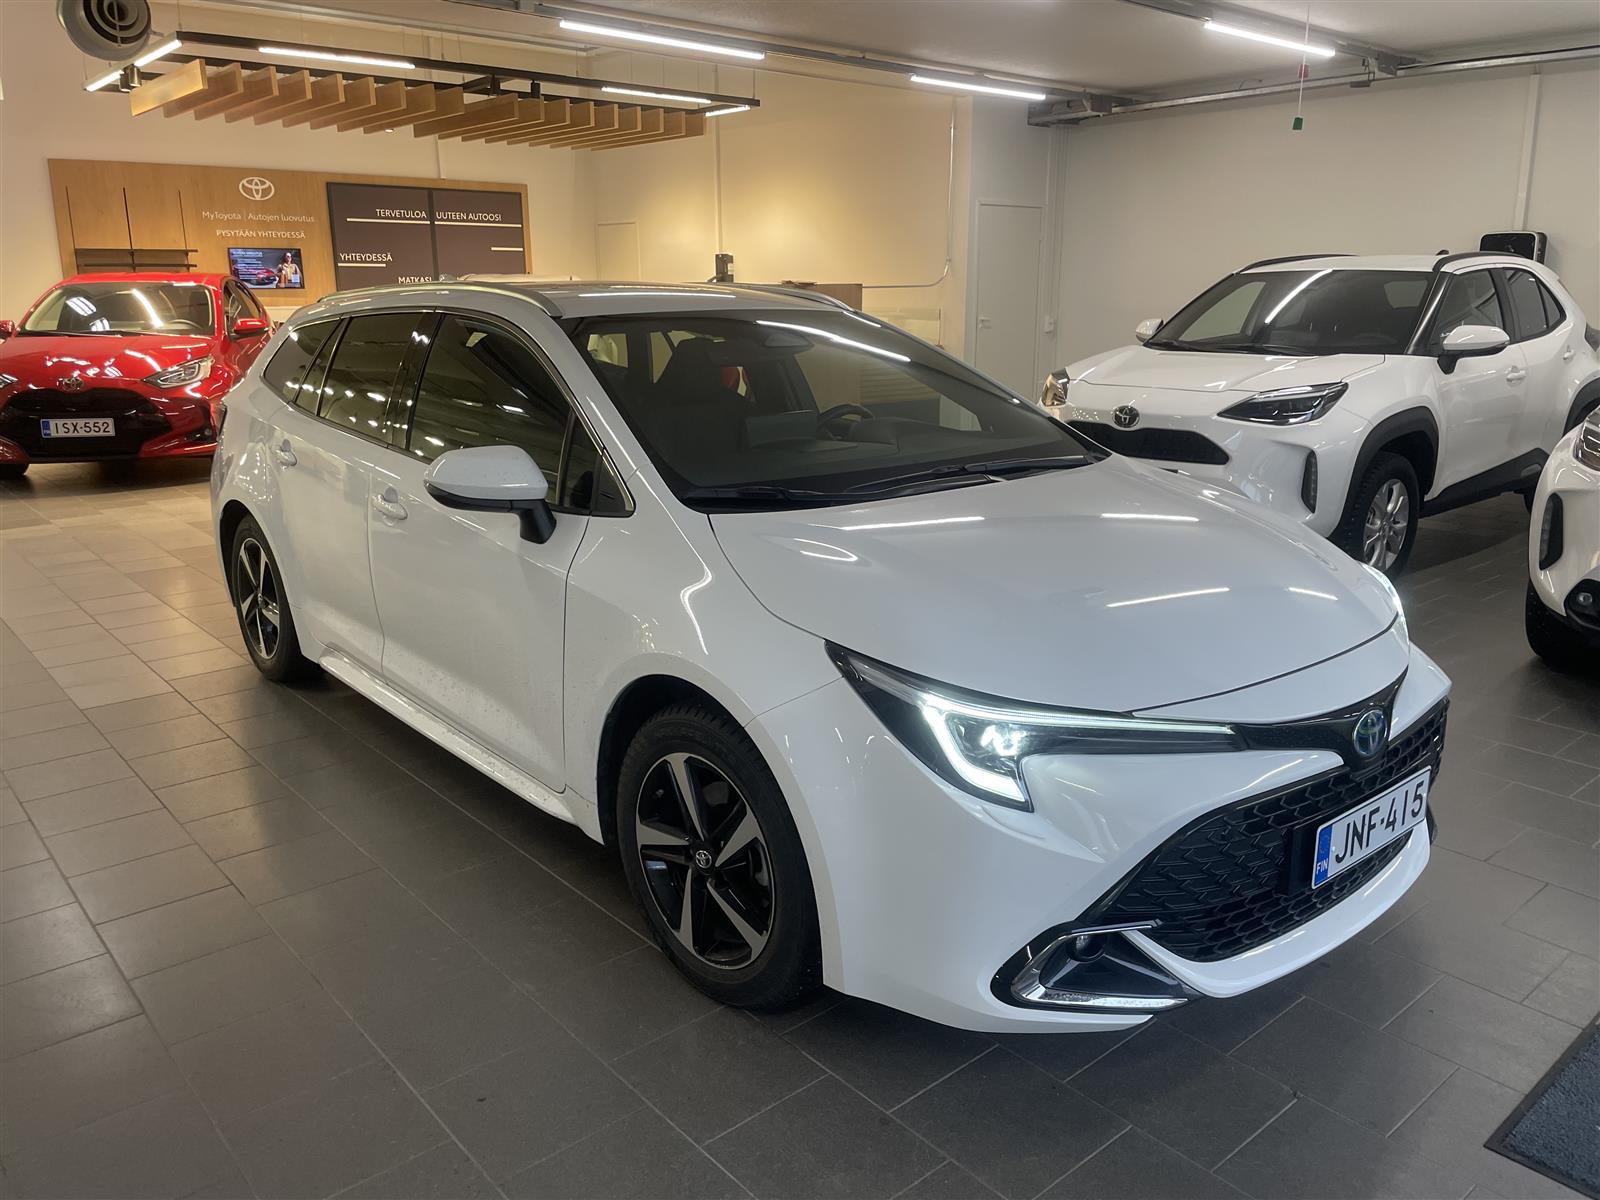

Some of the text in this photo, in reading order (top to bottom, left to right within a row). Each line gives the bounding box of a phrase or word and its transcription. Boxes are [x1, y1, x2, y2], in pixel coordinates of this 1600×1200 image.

[202, 211, 315, 223] MyToyota Autojen luovutus
[375, 208, 502, 221] TERVETULOA UUTEEN AUTOOSI
[216, 228, 306, 239] PYSYTÄÄN YHTEYDESSÄ
[339, 252, 393, 262] YHTEYDESSÄ
[398, 276, 432, 284] MATKASI
[55, 421, 111, 435] ISX-552
[1335, 780, 1425, 864] JNF-415
[1316, 857, 1329, 875] FIN
